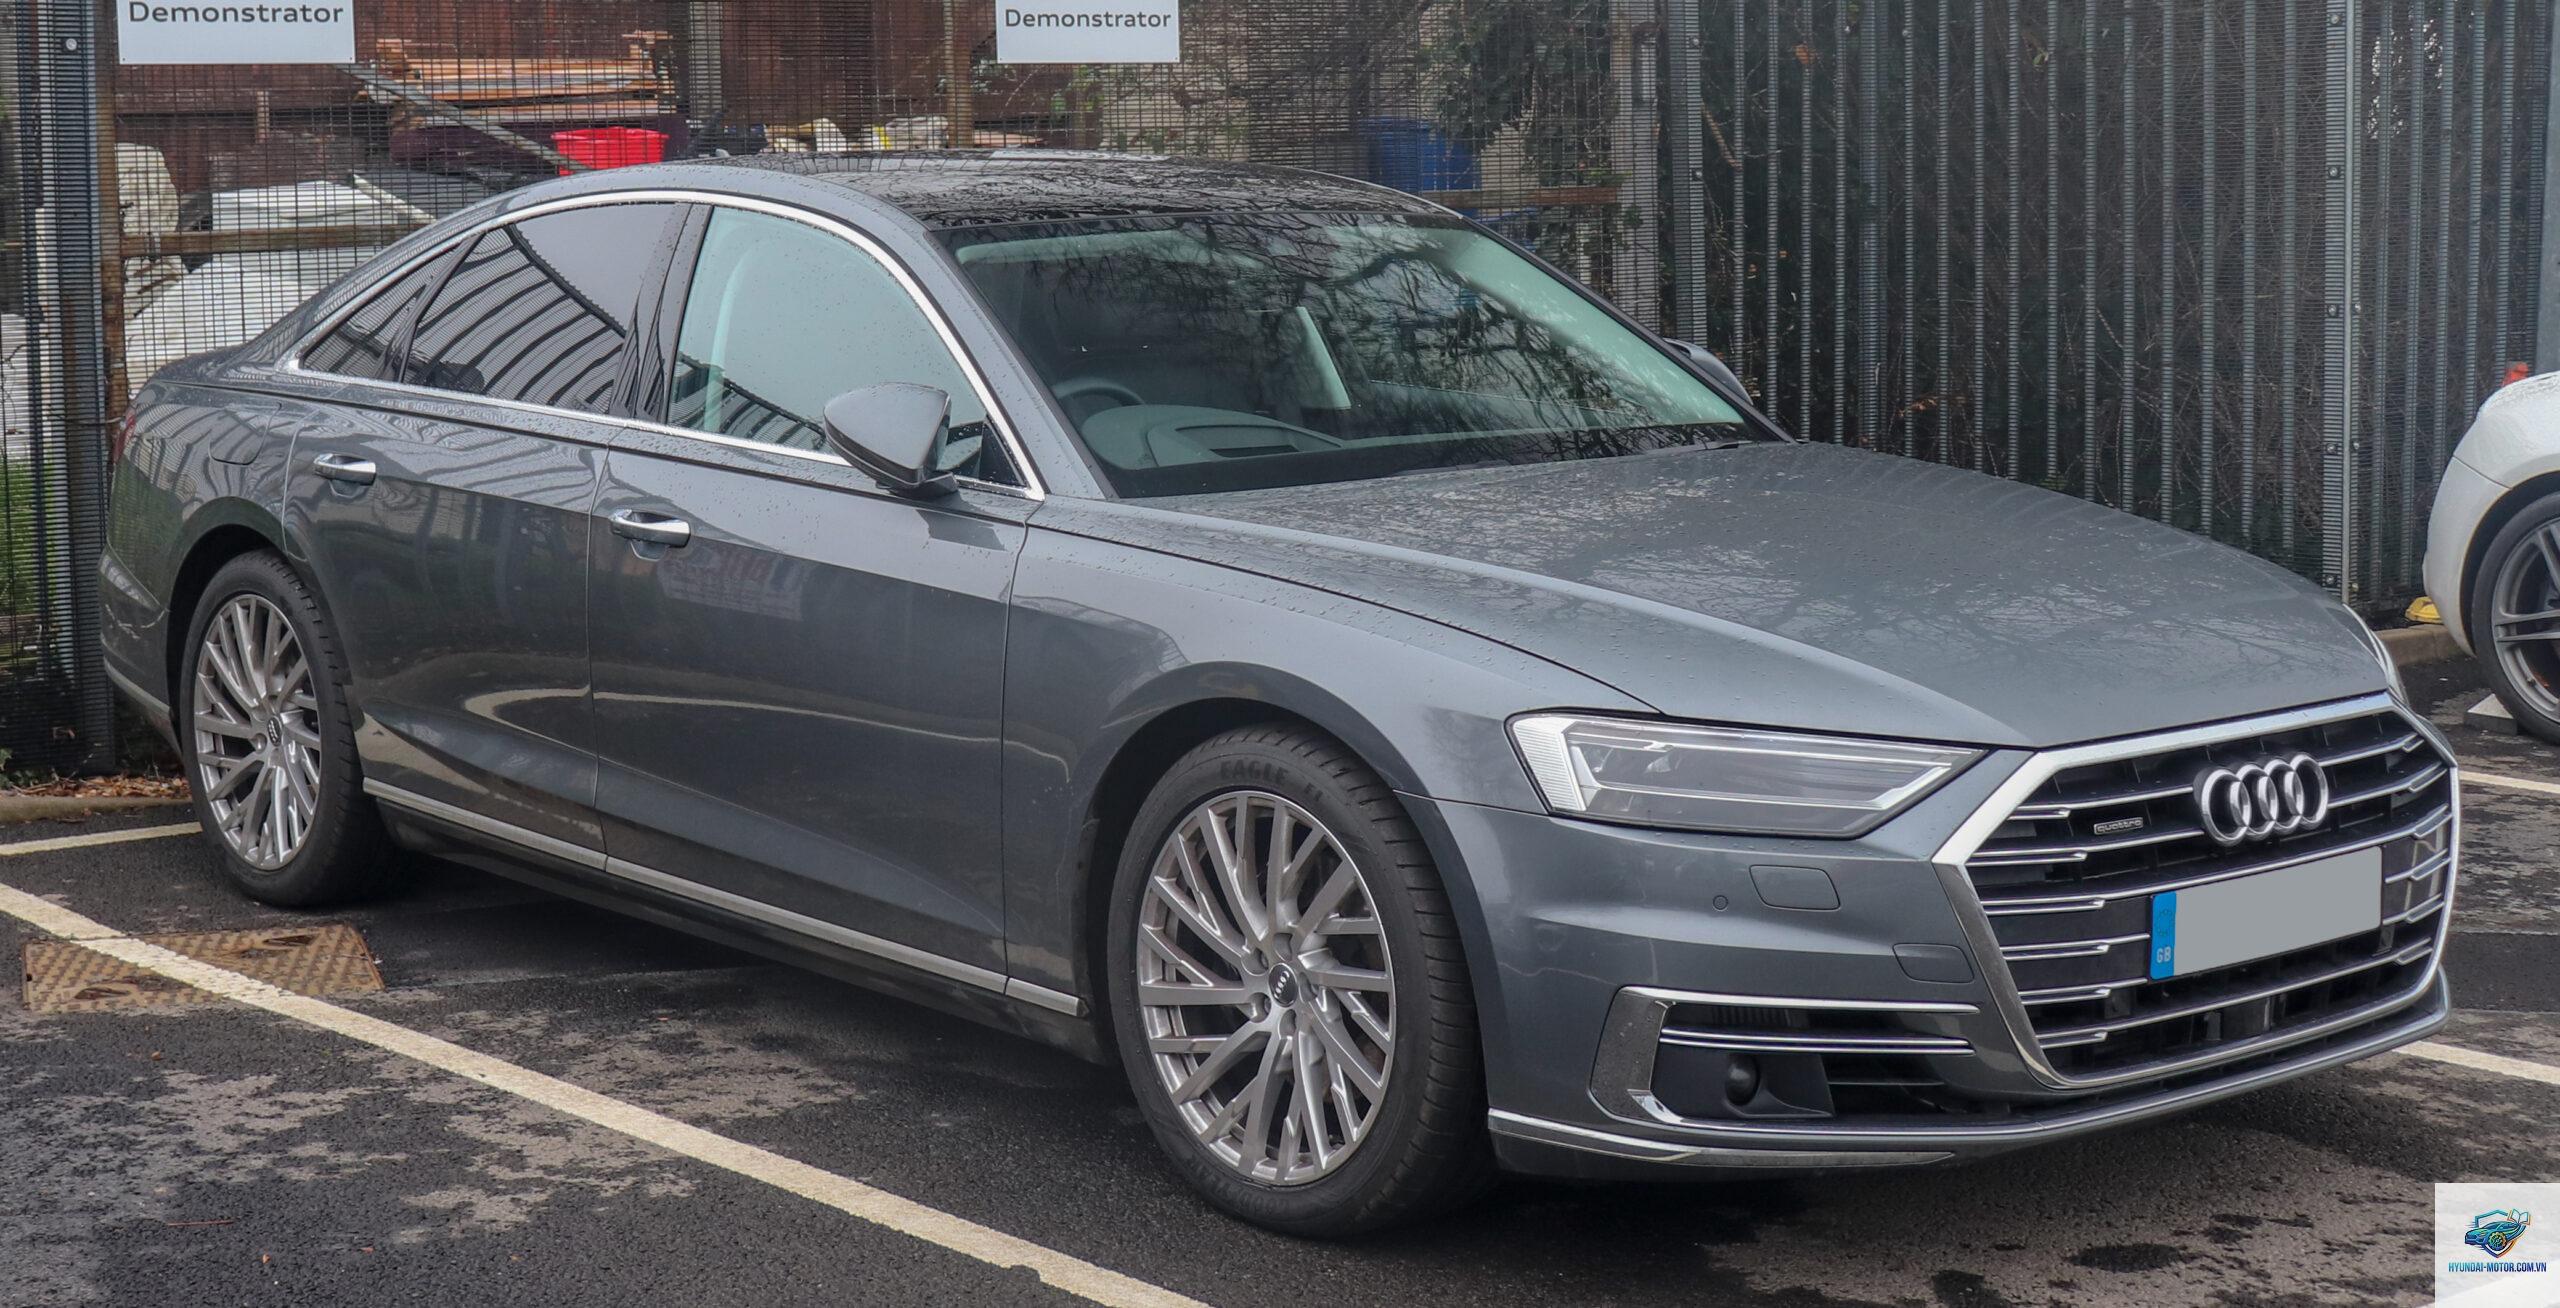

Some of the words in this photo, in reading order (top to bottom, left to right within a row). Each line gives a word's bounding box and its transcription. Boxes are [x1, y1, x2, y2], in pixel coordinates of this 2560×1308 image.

[129, 1, 344, 23] Demonstrator
[1005, 9, 1172, 28] Demonstrator
[1219, 759, 1290, 786] EAGLE
[2096, 819, 2142, 834] quattro
[2156, 946, 2172, 964] GB
